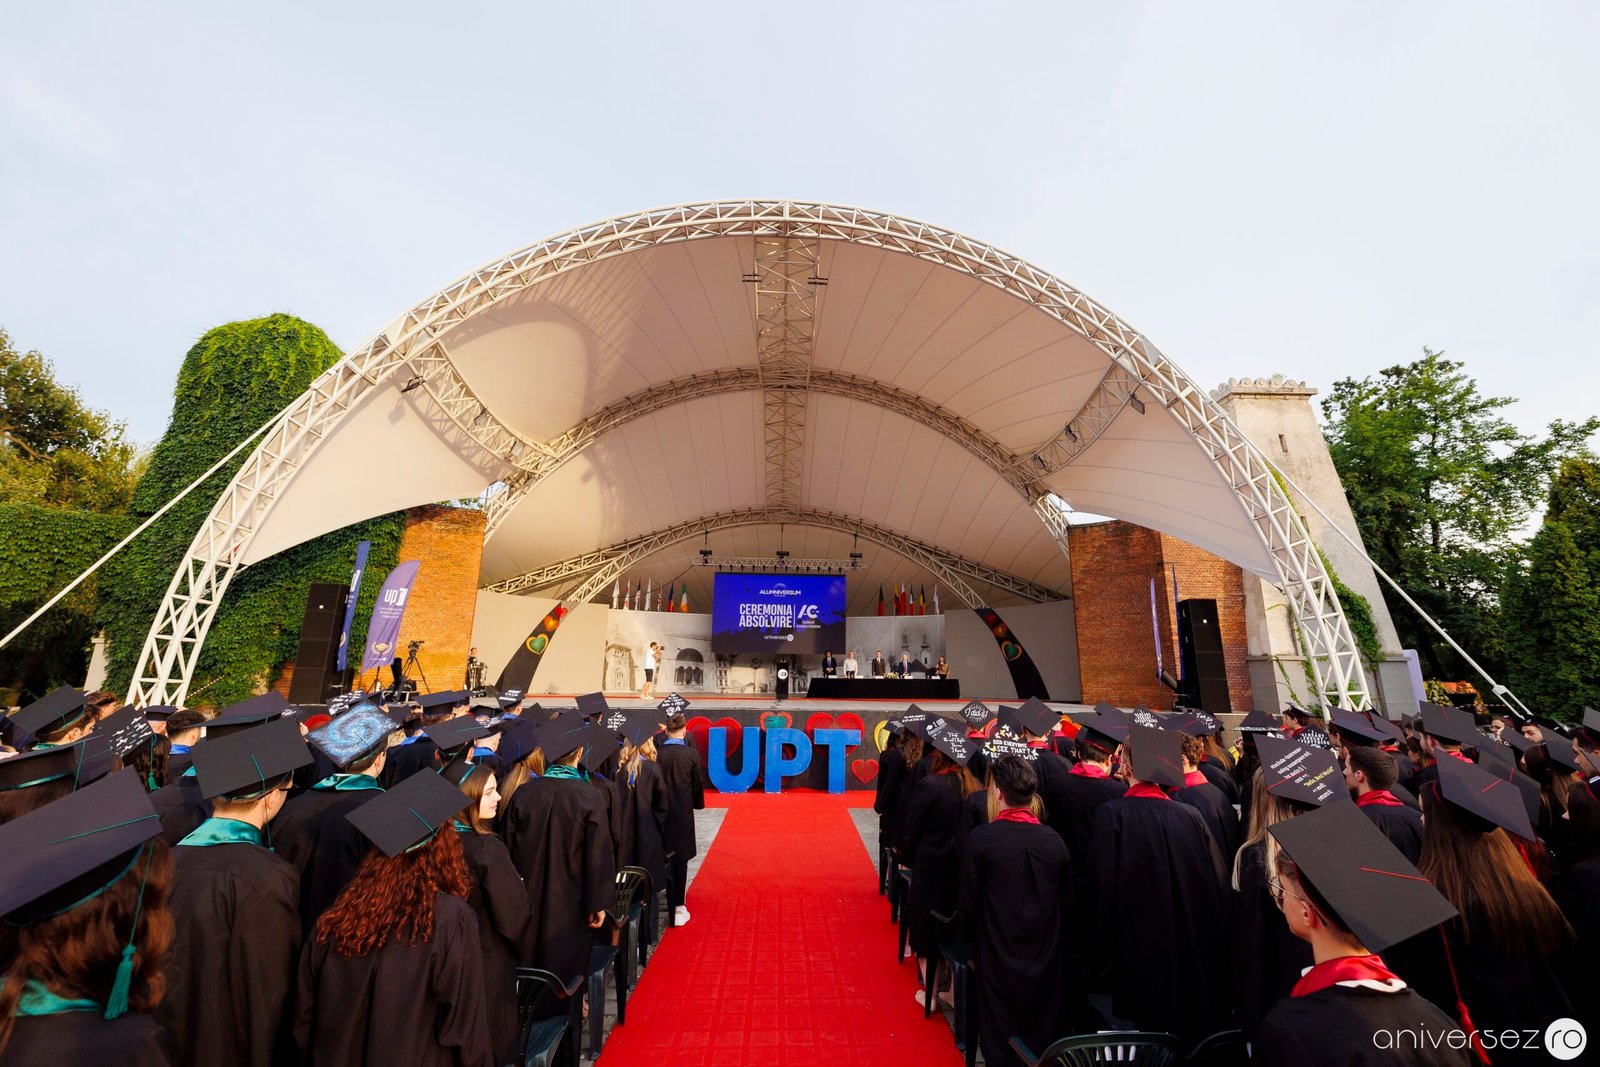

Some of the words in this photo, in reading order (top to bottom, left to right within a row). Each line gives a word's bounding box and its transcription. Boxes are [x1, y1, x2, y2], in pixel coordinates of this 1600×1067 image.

[739, 604, 792, 615] CEREMONIA
[739, 615, 792, 628] ABSOLVIRE
[708, 727, 861, 794] UPT
